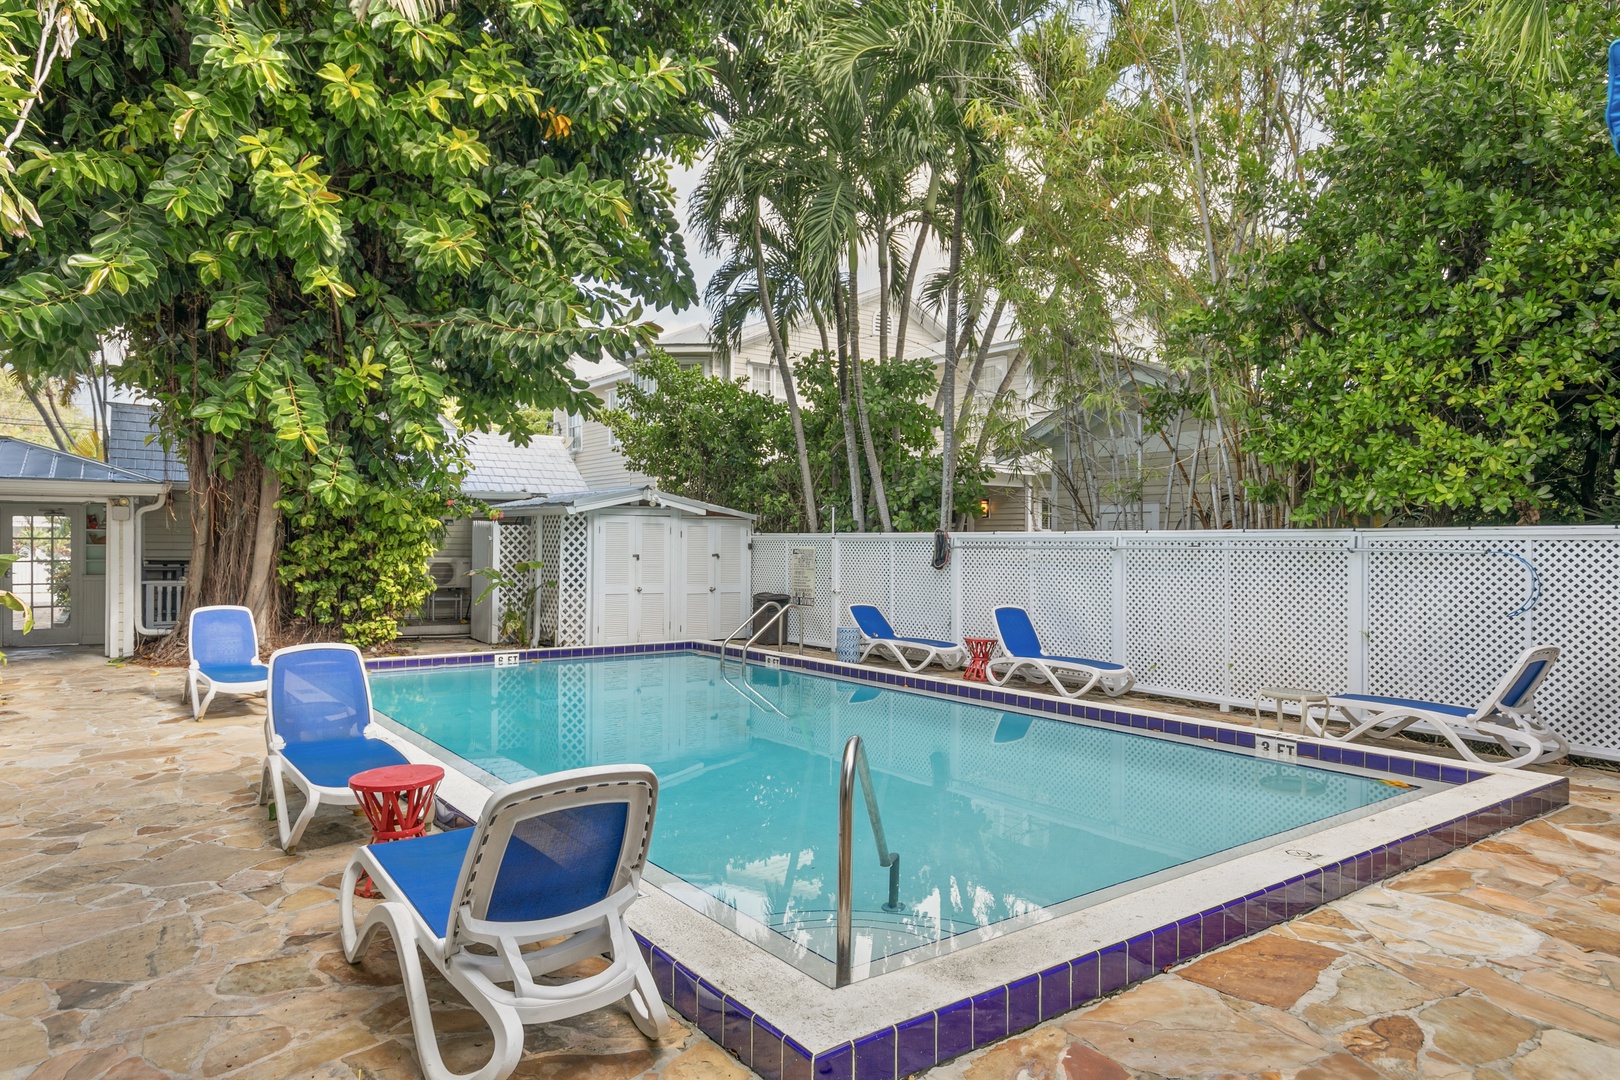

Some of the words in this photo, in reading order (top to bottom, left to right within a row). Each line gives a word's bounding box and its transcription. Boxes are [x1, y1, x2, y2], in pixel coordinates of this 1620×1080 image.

[508, 655, 518, 665] FT
[1261, 741, 1270, 751] 3
[1277, 743, 1295, 755] FT
